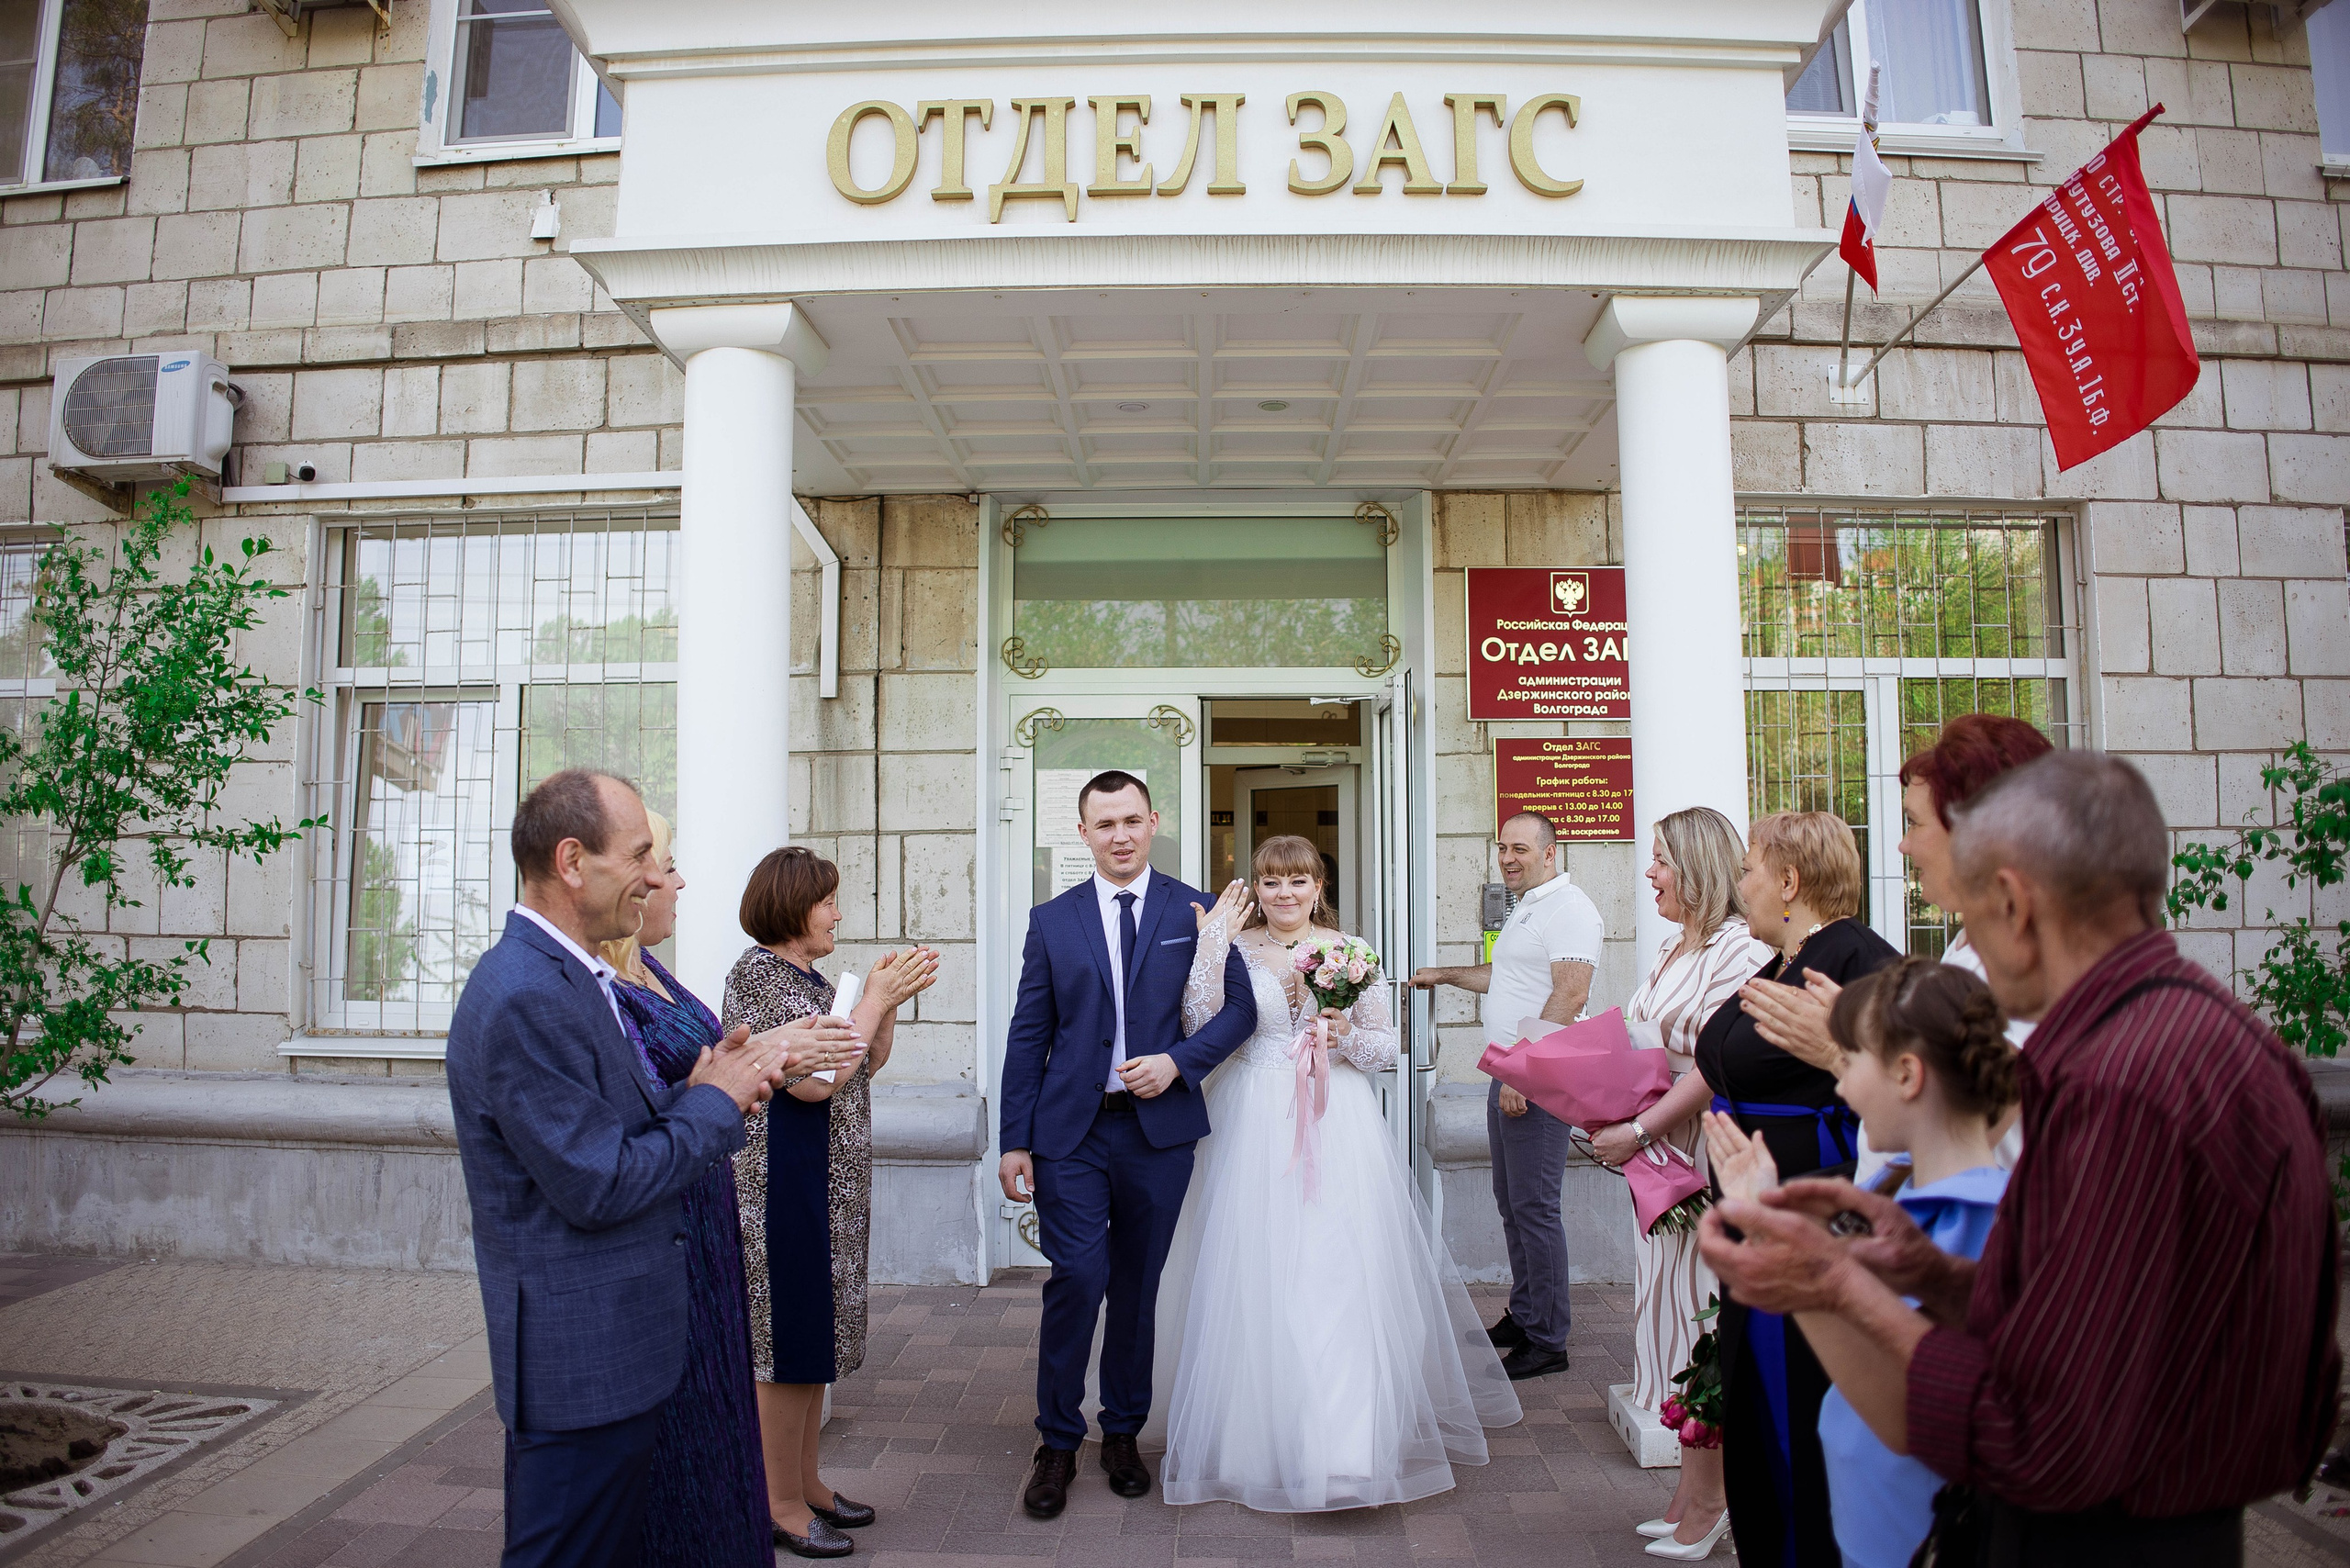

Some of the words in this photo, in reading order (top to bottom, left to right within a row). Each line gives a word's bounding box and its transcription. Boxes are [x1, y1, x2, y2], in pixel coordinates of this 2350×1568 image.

[826, 93, 1247, 224] ОТДЕЛ
[1285, 91, 1585, 198] ЗАГС
[2010, 226, 2057, 279] 79
[2076, 248, 2101, 287] ДИВ.
[1496, 619, 1570, 630] Российская
[1481, 636, 1576, 666] Отдел
[1517, 676, 1622, 688] администрации
[1496, 689, 1593, 701] Дзержинского
[1533, 703, 1608, 716] Волгограда
[1542, 742, 1573, 752] Отдел
[1575, 741, 1601, 751] ЗАГС
[1536, 776, 1571, 787] График
[1572, 776, 1608, 787] работы:
[1499, 791, 1585, 800] понедельник-пятница
[1592, 790, 1610, 798] 8.30
[1522, 804, 1558, 812] перерыв
[1564, 802, 1587, 811] 13.00
[1600, 801, 1624, 810] 14.00
[1566, 815, 1584, 823] 8.30
[1597, 814, 1620, 823] 17.00
[1571, 828, 1620, 836] воскресенье
